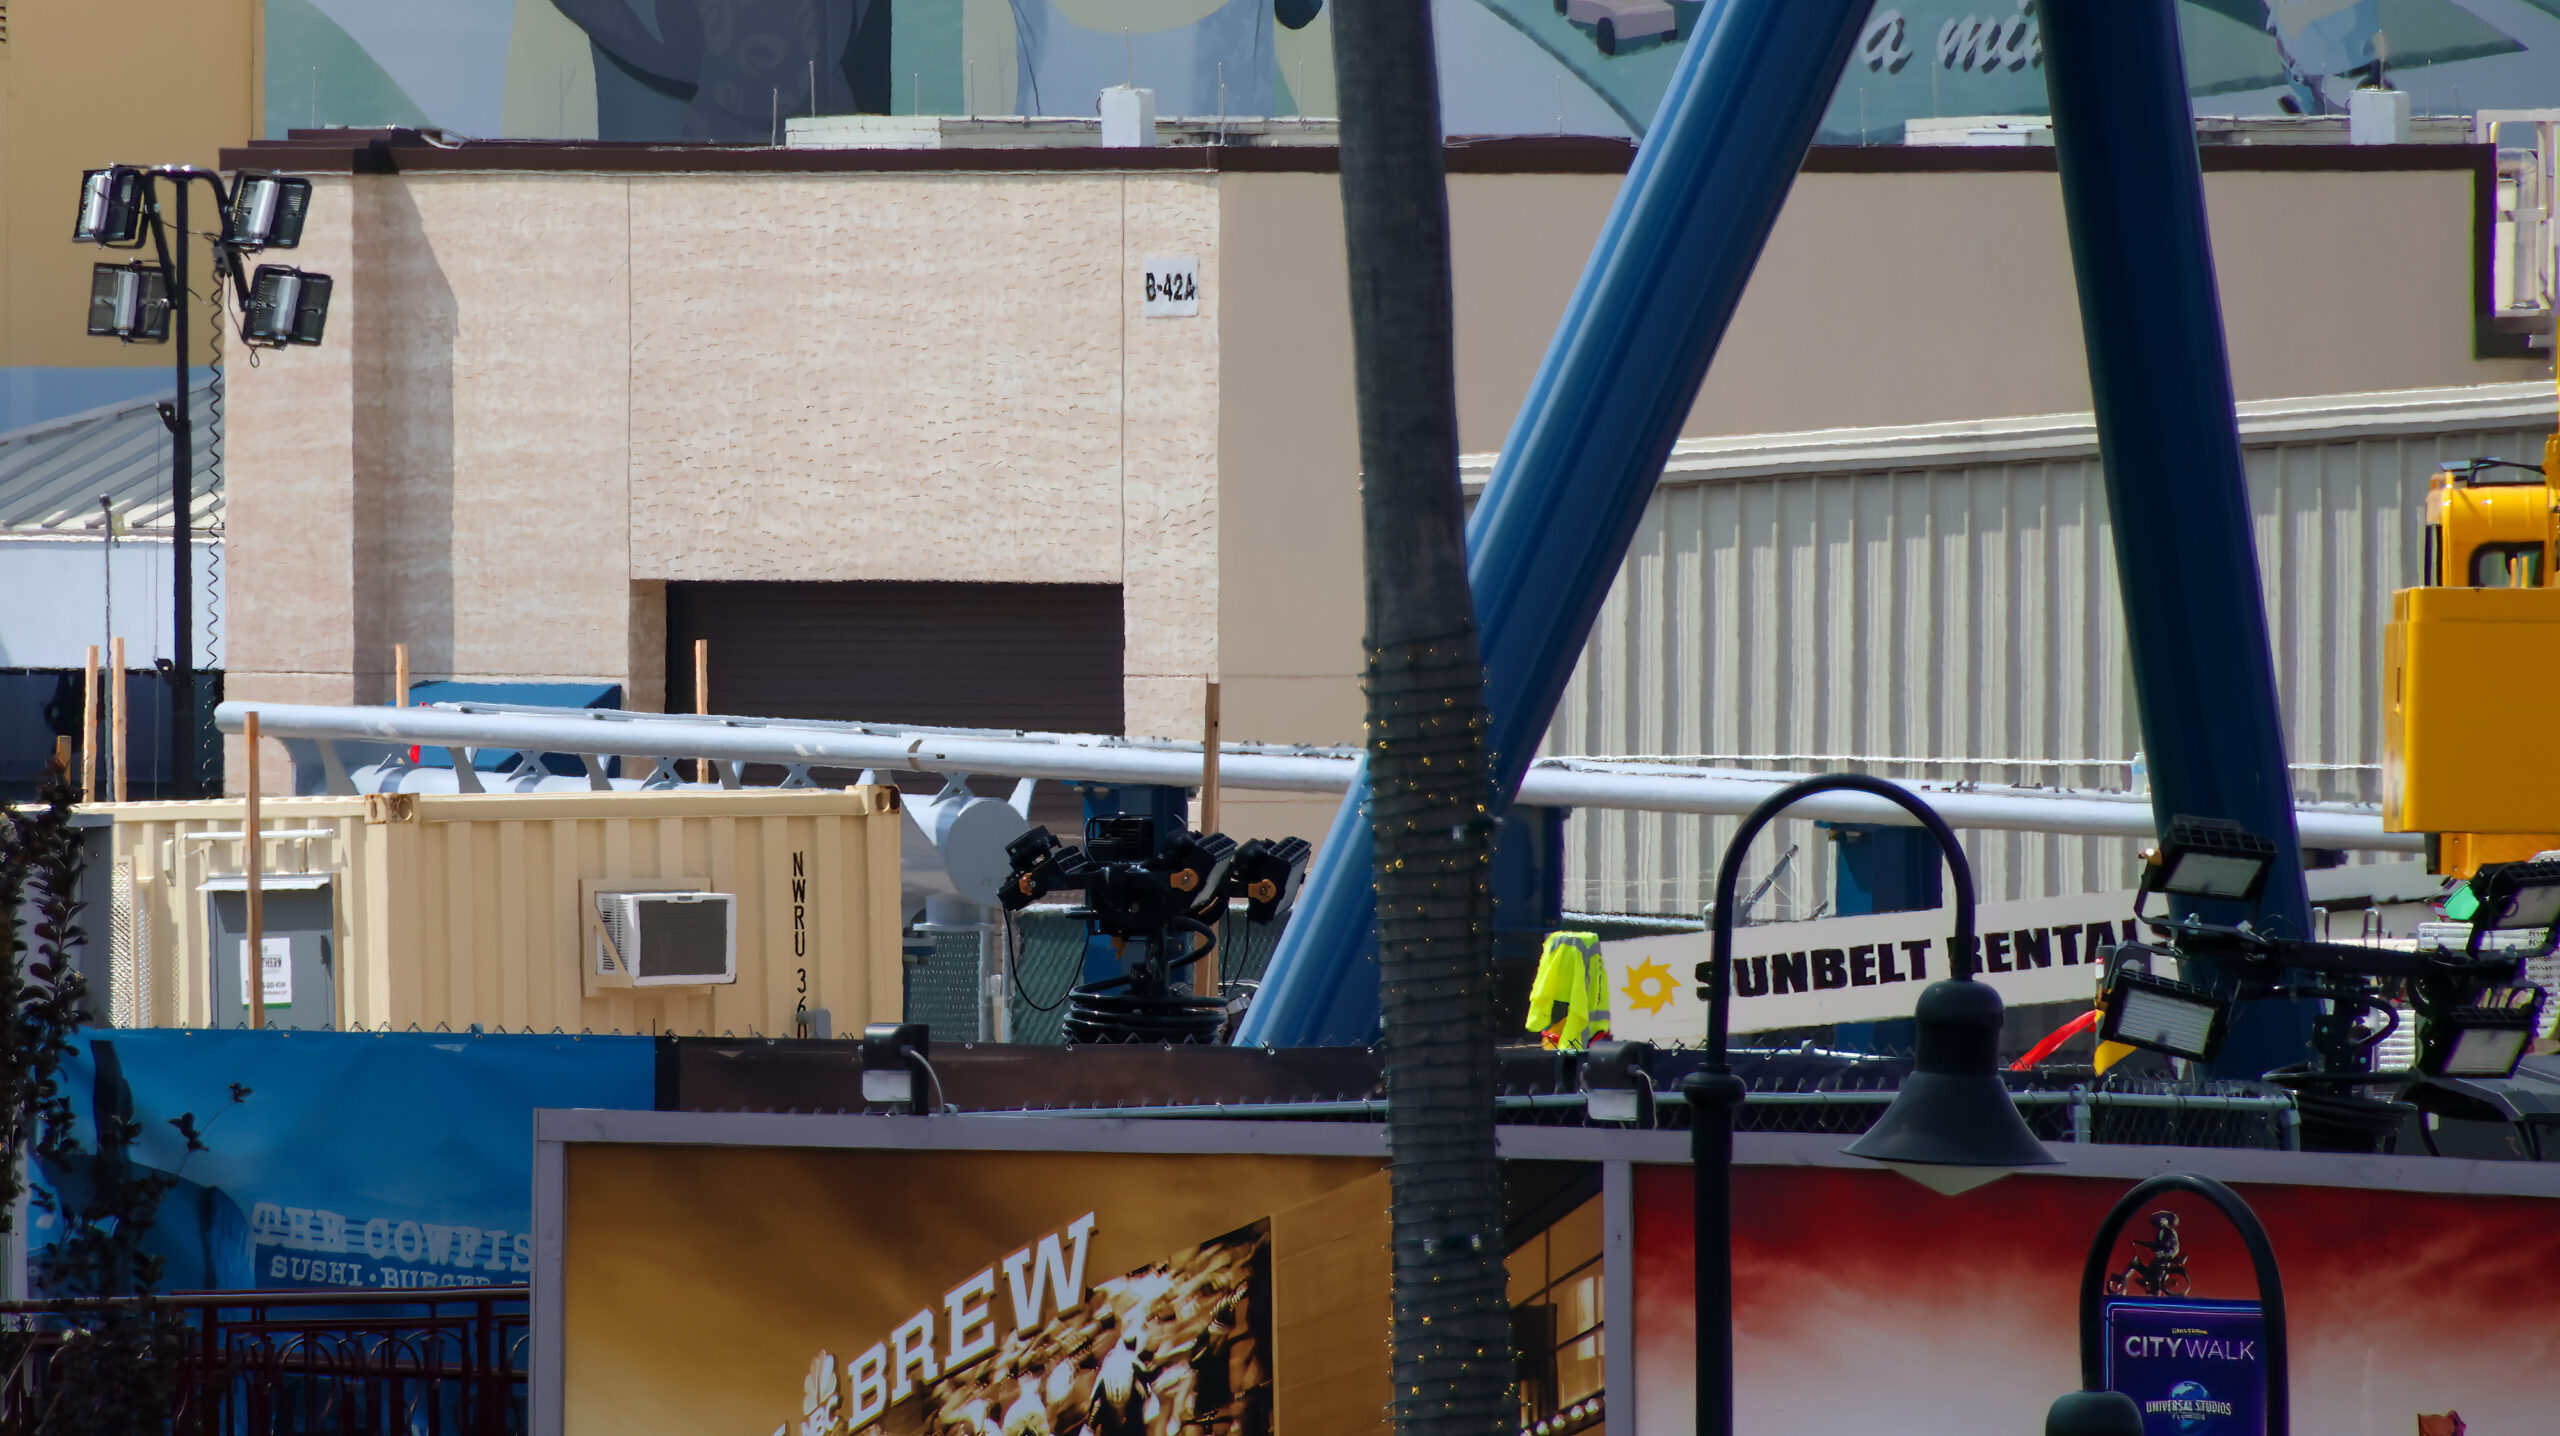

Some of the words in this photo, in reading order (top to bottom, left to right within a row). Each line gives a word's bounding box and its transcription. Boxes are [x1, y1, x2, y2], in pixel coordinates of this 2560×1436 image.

[1146, 272, 1195, 302] B-42A
[792, 851, 806, 957] NWRU
[848, 1211, 1095, 1432] BREW
[2194, 1400, 2232, 1416] STUDIOS
